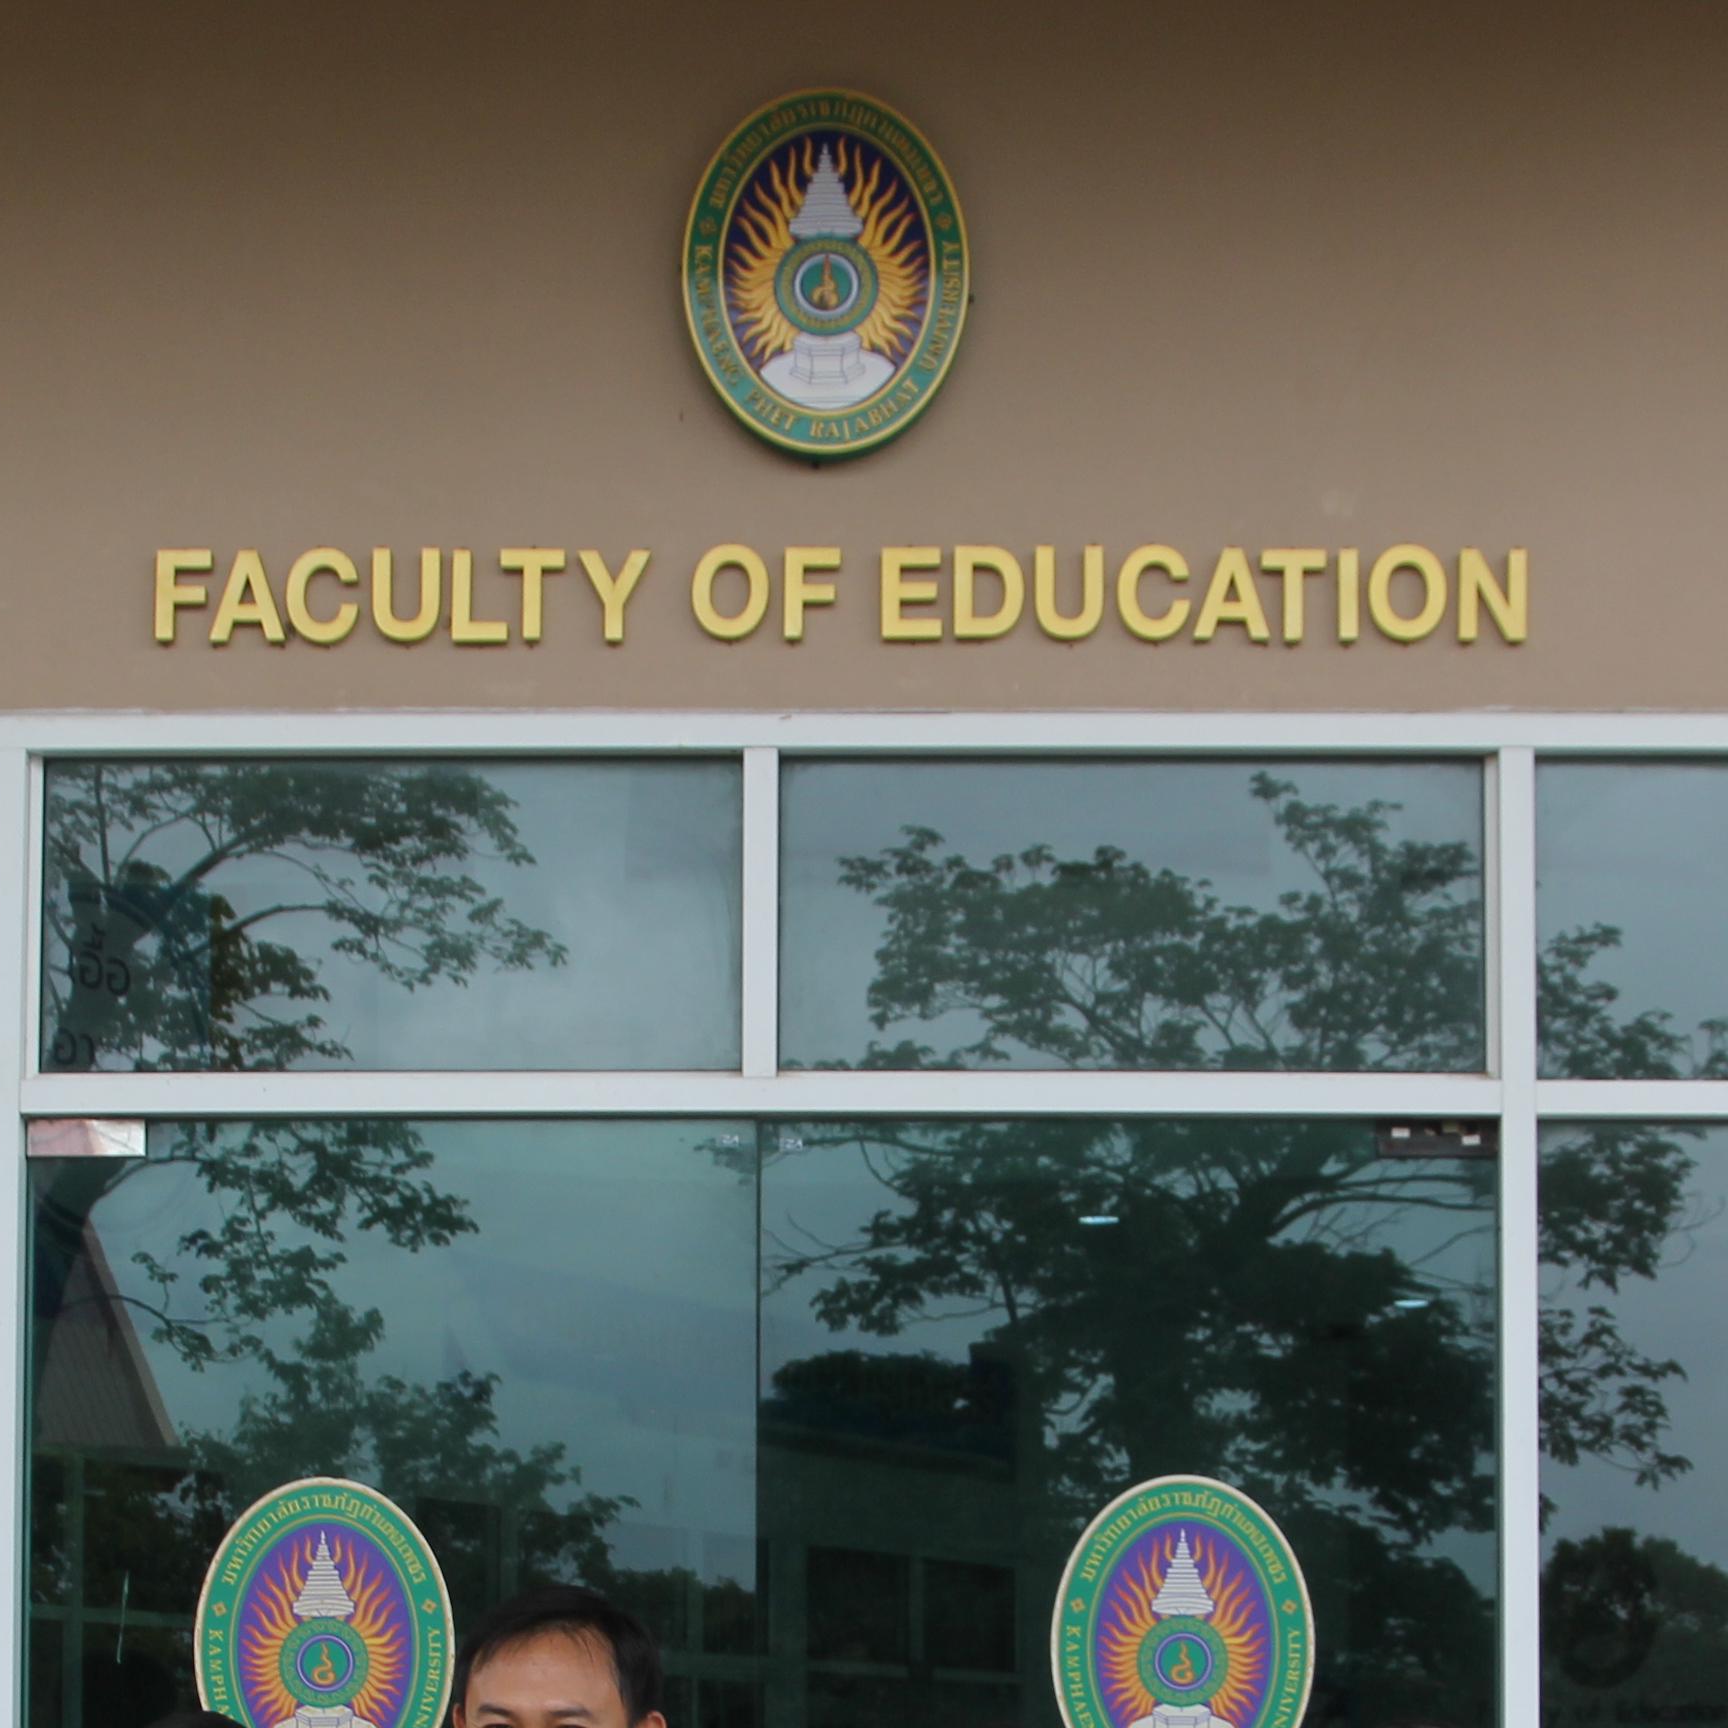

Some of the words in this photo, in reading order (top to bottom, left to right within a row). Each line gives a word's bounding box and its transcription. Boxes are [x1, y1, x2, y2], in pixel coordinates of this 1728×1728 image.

[694, 243, 747, 387] KAMPHAENG
[746, 388, 800, 432] PHET
[809, 379, 920, 440] RAJABHAT
[918, 240, 962, 373] UNIVERSITY
[153, 546, 652, 646] FACULTY
[688, 543, 842, 645] OF
[880, 543, 1530, 645] EDUCATION
[208, 1628, 233, 1722] KAMPH
